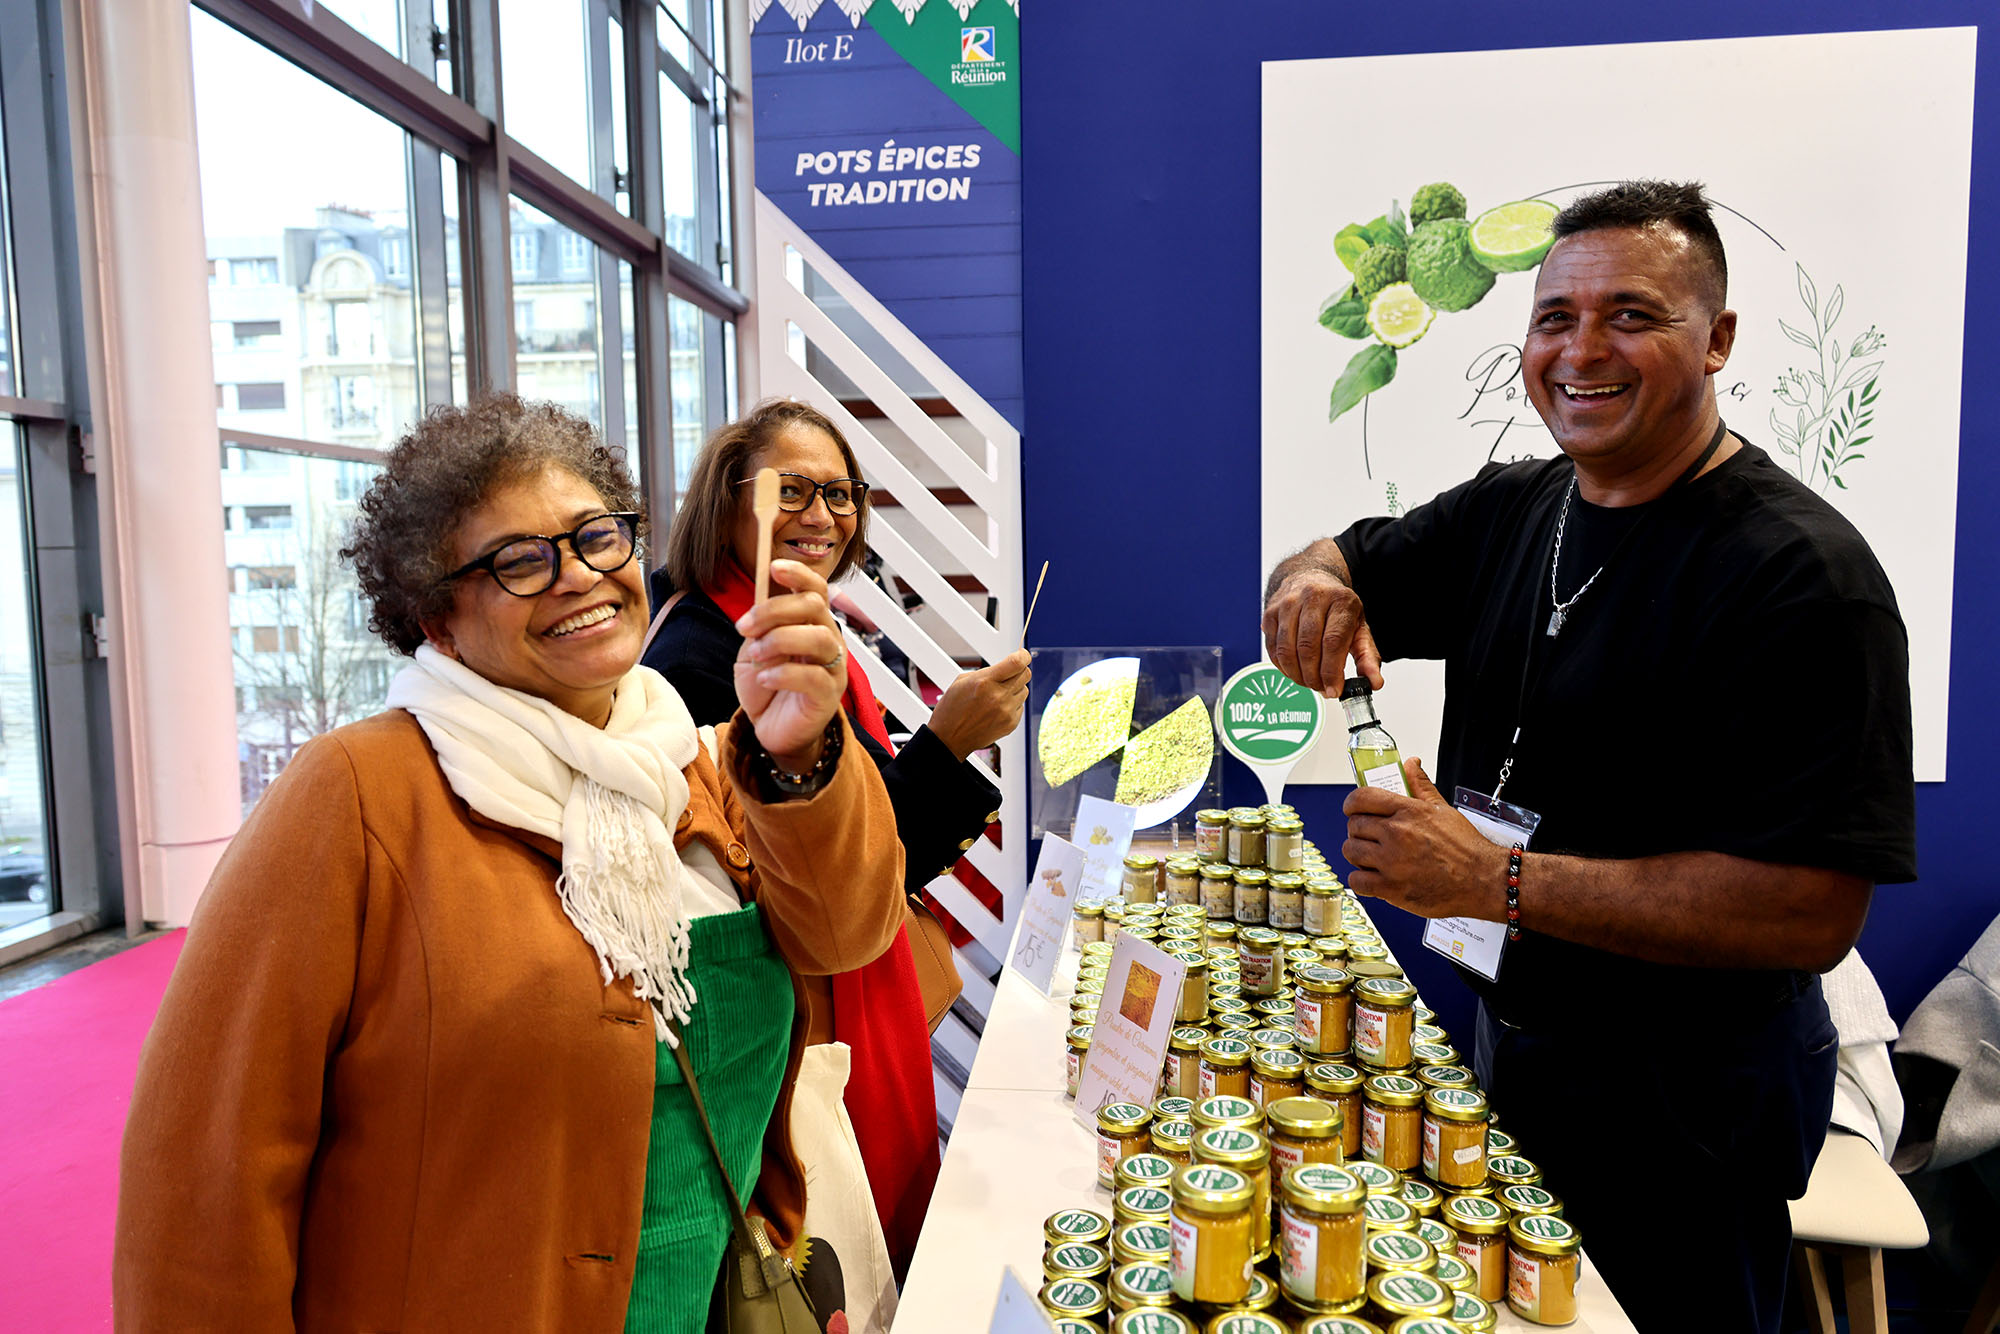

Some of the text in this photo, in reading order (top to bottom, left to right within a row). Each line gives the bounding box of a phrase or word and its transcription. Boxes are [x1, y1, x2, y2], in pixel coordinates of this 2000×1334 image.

[784, 34, 855, 64] Ilot E
[951, 69, 1007, 84] Réunion
[795, 139, 981, 176] POTS ÉPICES
[807, 177, 971, 207] TRADITION
[1229, 702, 1312, 725] 100% LA RÉUNION
